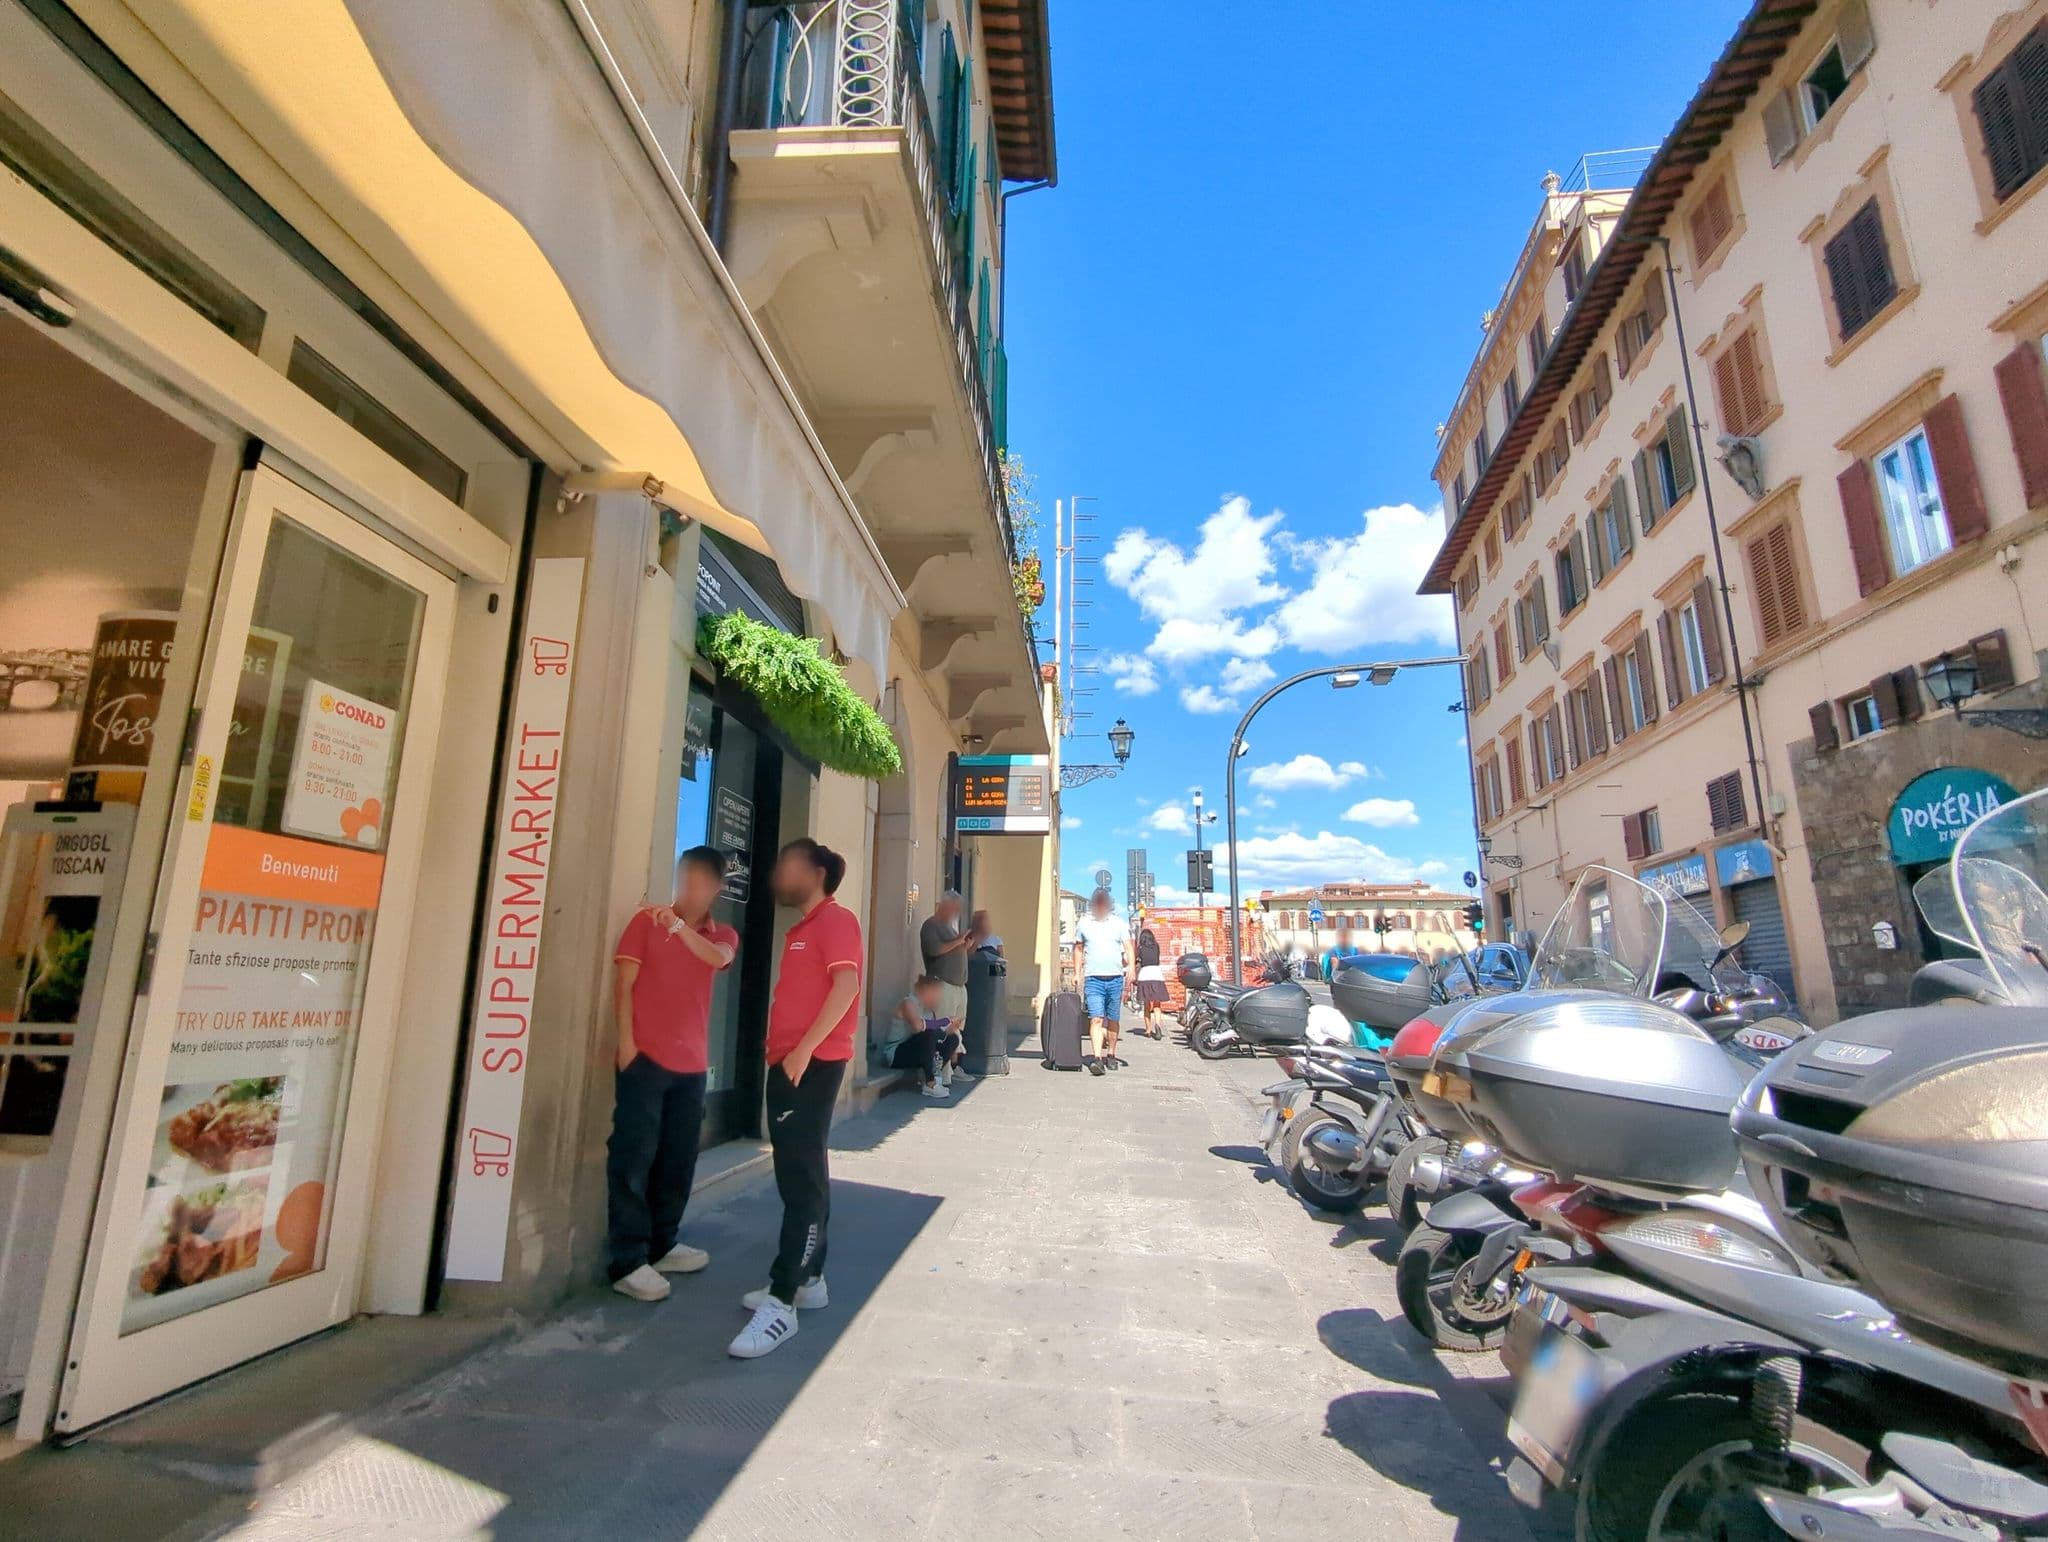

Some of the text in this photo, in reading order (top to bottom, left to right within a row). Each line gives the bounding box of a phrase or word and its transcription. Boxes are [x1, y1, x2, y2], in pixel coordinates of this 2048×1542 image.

[335, 701, 386, 729] CONAD
[1901, 784, 2000, 837] POKÉRIA
[261, 853, 339, 882] Benvenuti
[482, 722, 561, 1073] SUPERMARKET
[195, 896, 293, 939] PIATTI
[188, 949, 222, 966] Tante
[226, 951, 270, 968] sfiziose
[273, 956, 320, 971] proposte
[176, 1011, 208, 1031] TRY
[213, 1011, 247, 1030] OUR
[252, 1011, 289, 1029] TAKE
[291, 1010, 332, 1028] AWAY
[170, 1041, 198, 1055] Many
[201, 1040, 243, 1053] delicious
[246, 1037, 289, 1051] proposals
